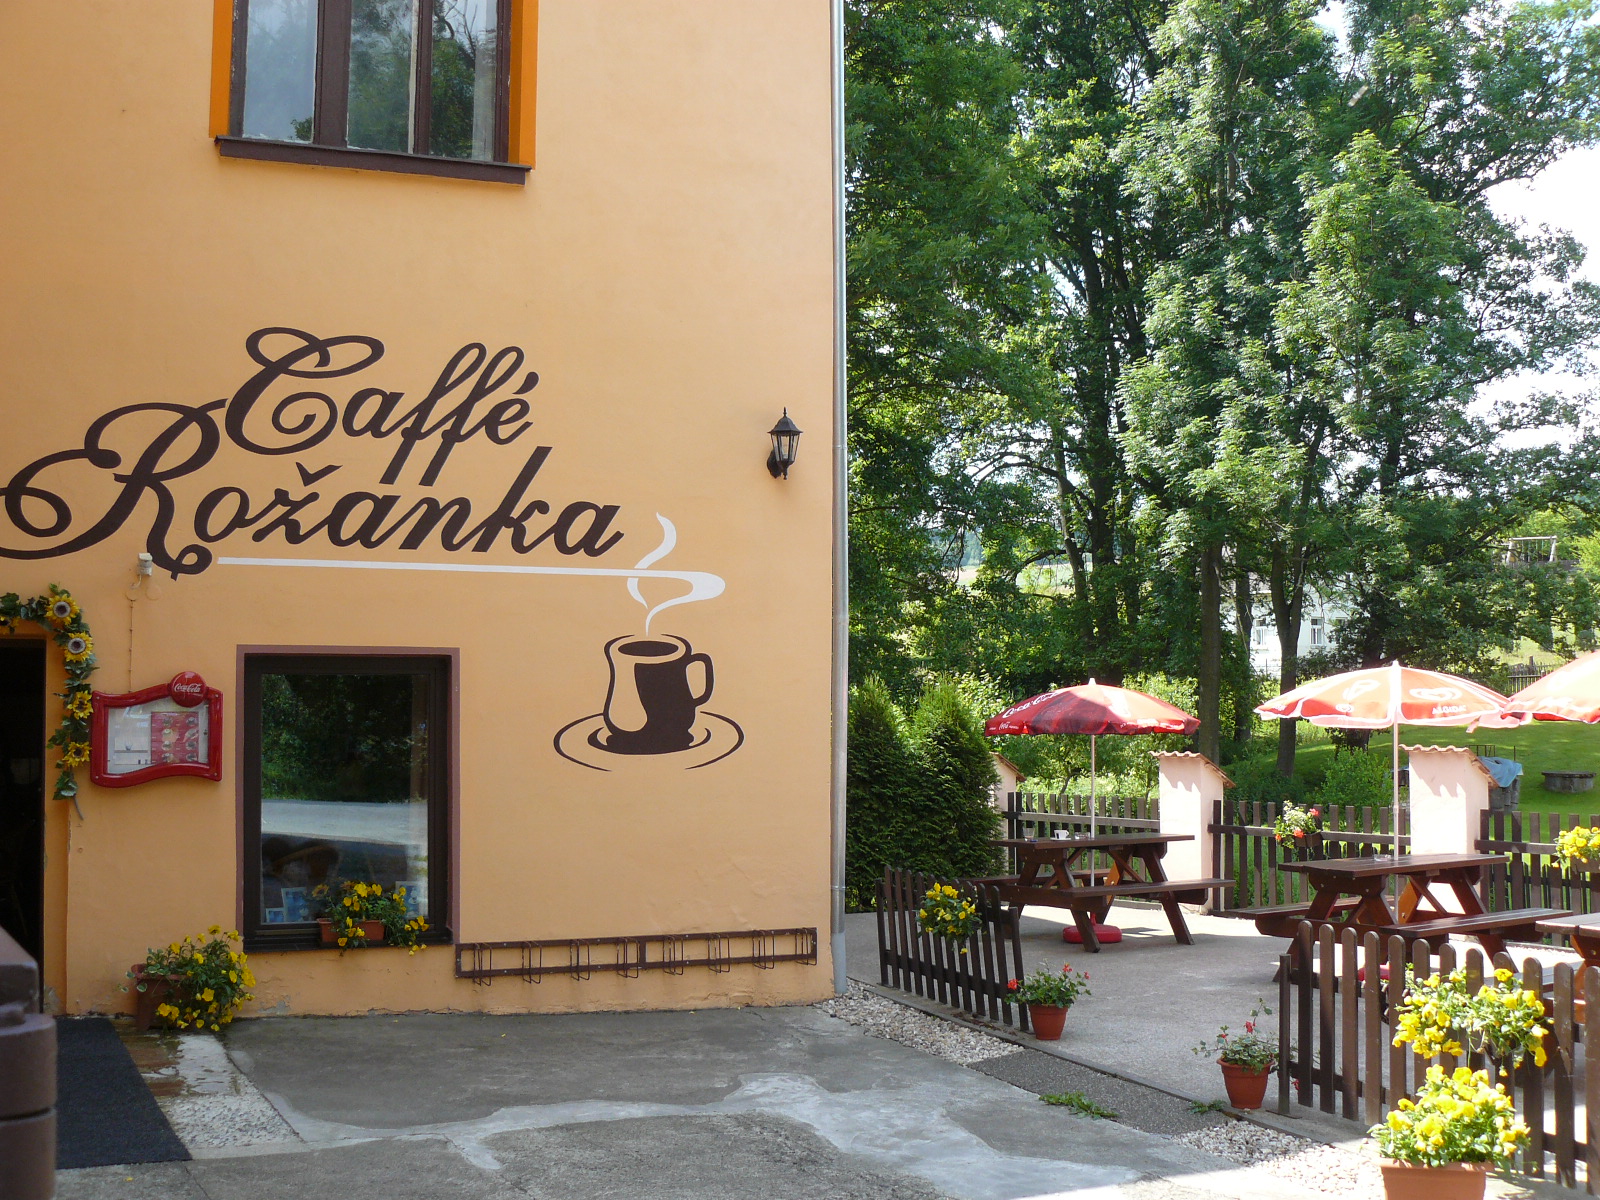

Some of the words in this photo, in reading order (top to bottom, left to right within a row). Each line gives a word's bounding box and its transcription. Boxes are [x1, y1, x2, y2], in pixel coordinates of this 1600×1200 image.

[225, 327, 538, 487] Caffé
[0, 399, 624, 580] Rožanka
[174, 683, 202, 693] Coca-Cola
